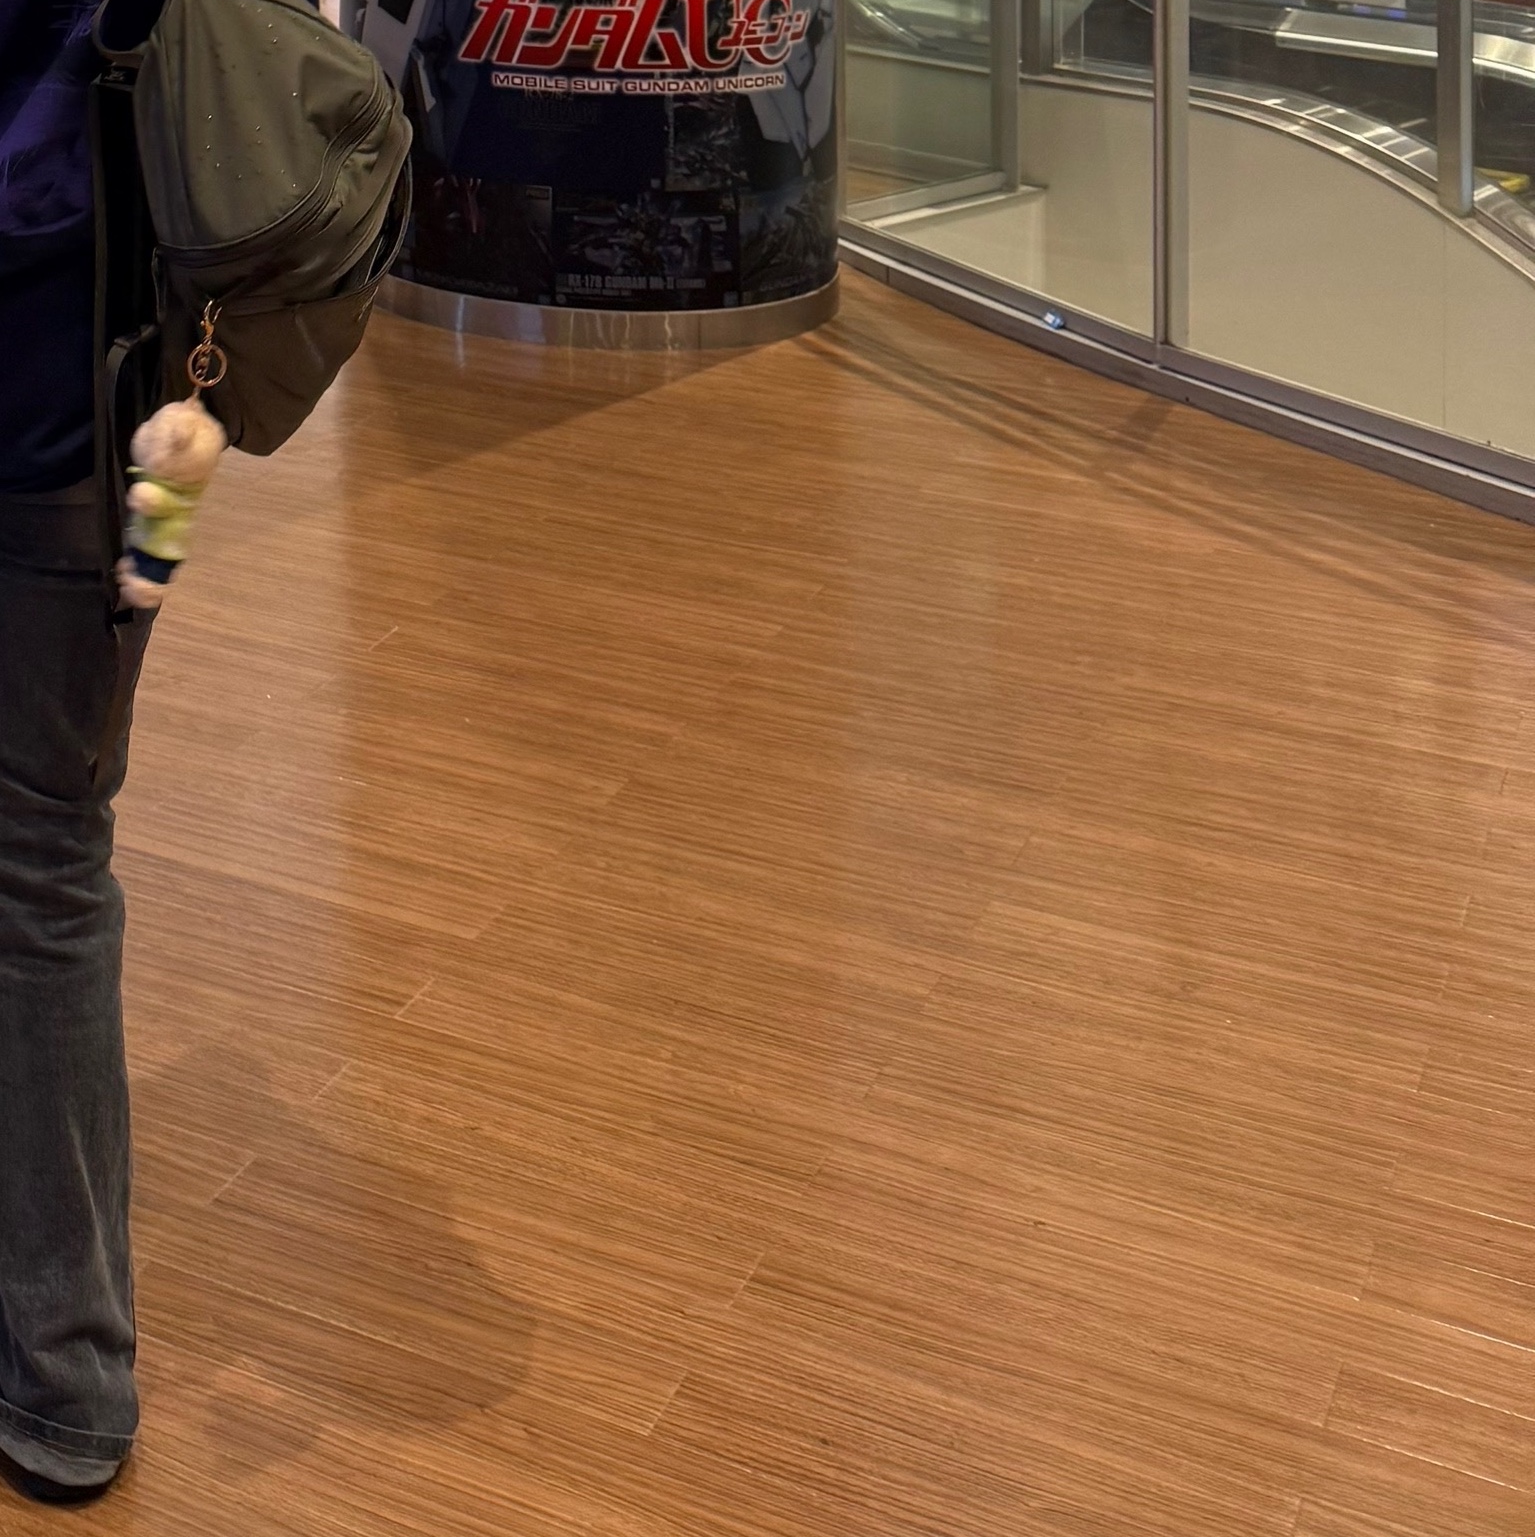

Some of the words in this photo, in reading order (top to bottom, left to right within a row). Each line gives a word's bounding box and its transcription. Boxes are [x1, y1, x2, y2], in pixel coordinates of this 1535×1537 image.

[493, 73, 566, 90] MOBILE
[573, 76, 618, 92] SUIT
[625, 78, 710, 93] GUNDAM
[715, 73, 785, 91] UNICORN
